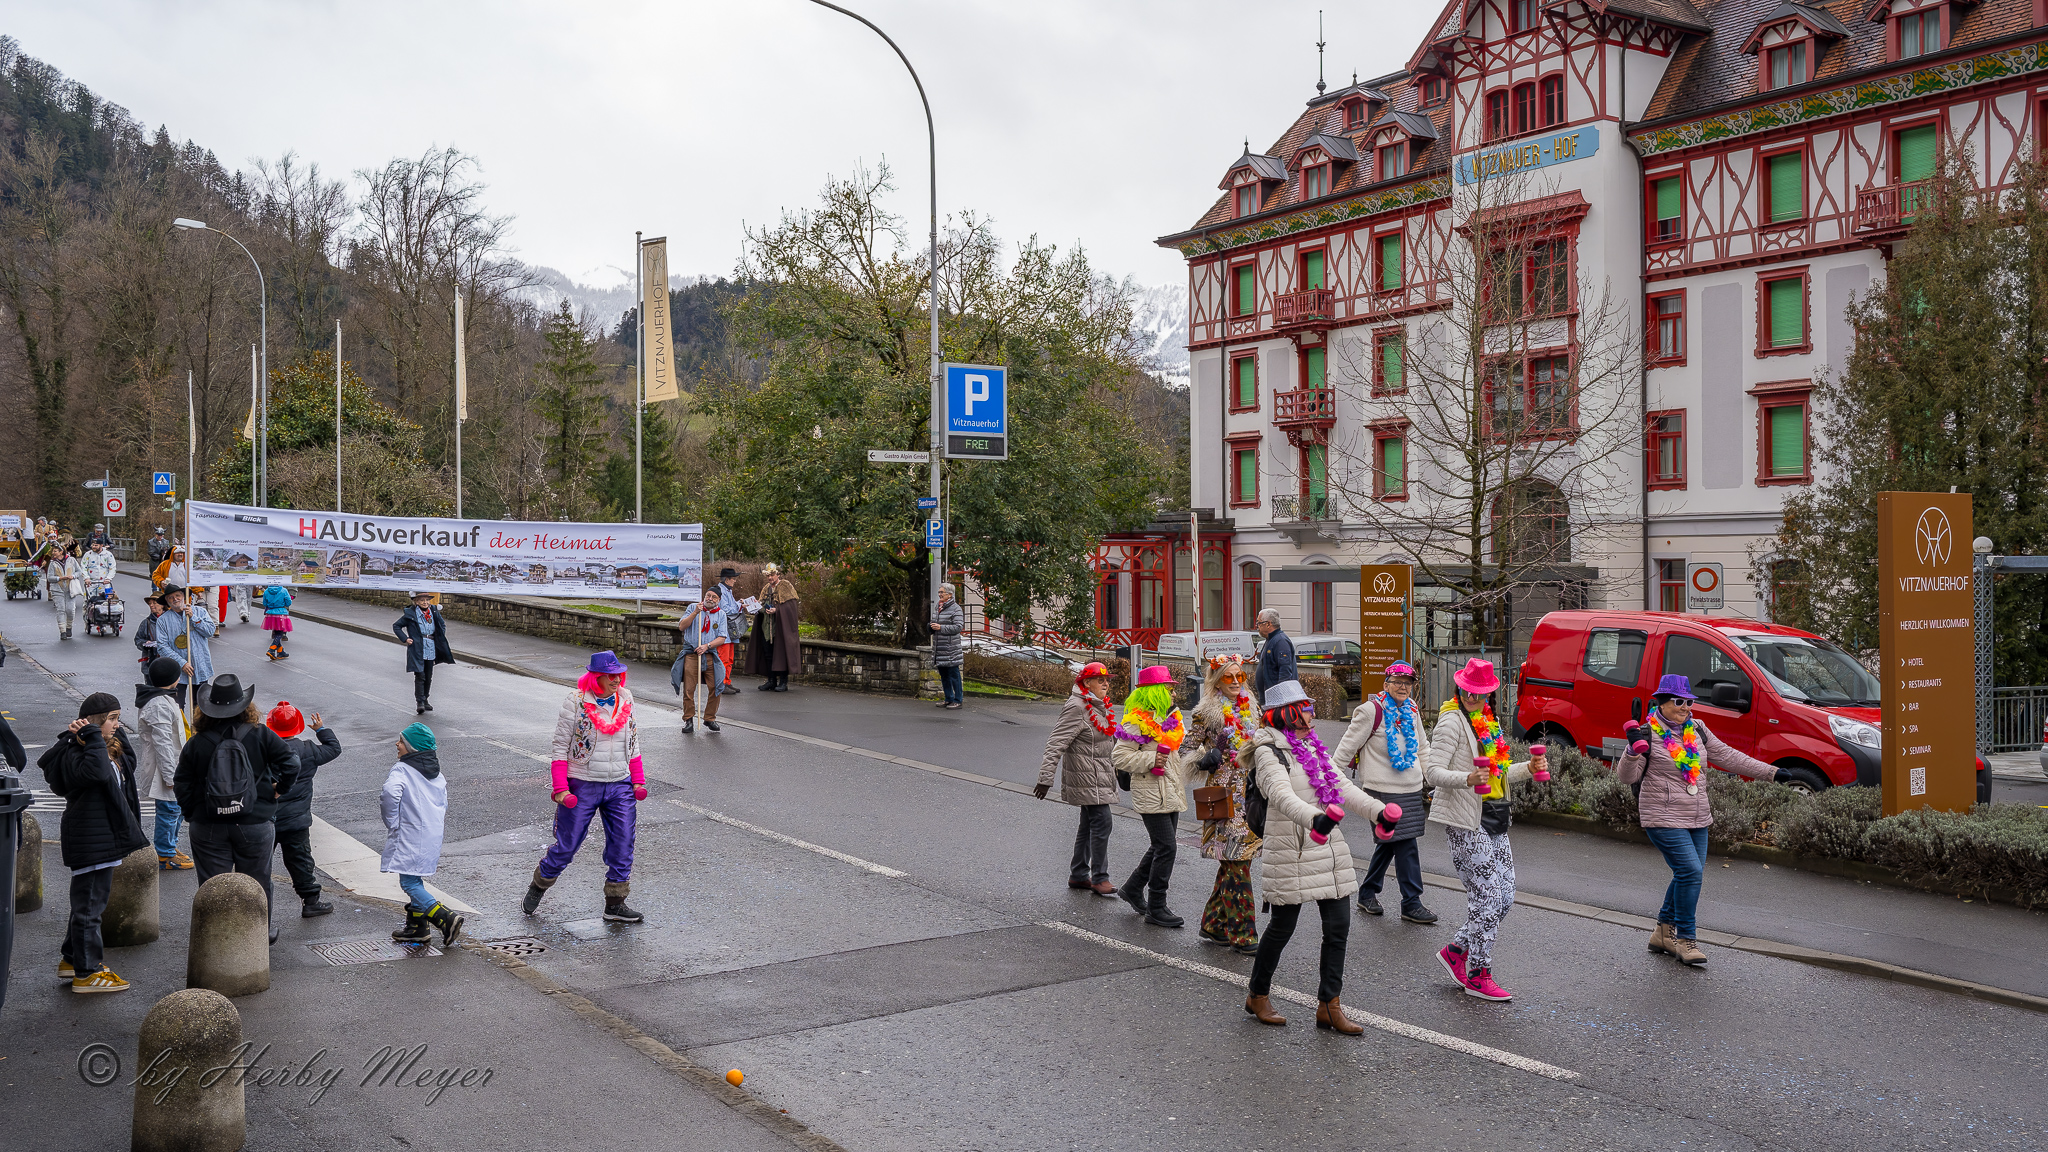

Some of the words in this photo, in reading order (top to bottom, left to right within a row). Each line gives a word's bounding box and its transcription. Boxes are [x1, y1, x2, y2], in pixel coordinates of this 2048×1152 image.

[1554, 134, 1580, 160] HOF
[652, 279, 667, 390] VITZNAUERHOF
[964, 374, 990, 416] P
[953, 418, 1000, 428] Vitznauerhof
[965, 440, 989, 450] FREI
[930, 520, 941, 536] P
[299, 518, 480, 548] HAUSverkauf
[490, 532, 528, 549] der
[533, 533, 616, 551] Heimat
[1899, 576, 1969, 592] VITZNAUERHOF
[1900, 620, 1928, 630] HERZLICH
[1929, 618, 1970, 629] WILLKOMMEN
[1908, 658, 1924, 666] HOTEL
[1908, 678, 1942, 688] RESTAURANTS
[1909, 702, 1919, 711] BAR
[1909, 725, 1919, 733] SPA
[1910, 745, 1932, 755] SEMINAR
[217, 805, 240, 814] PUMA
